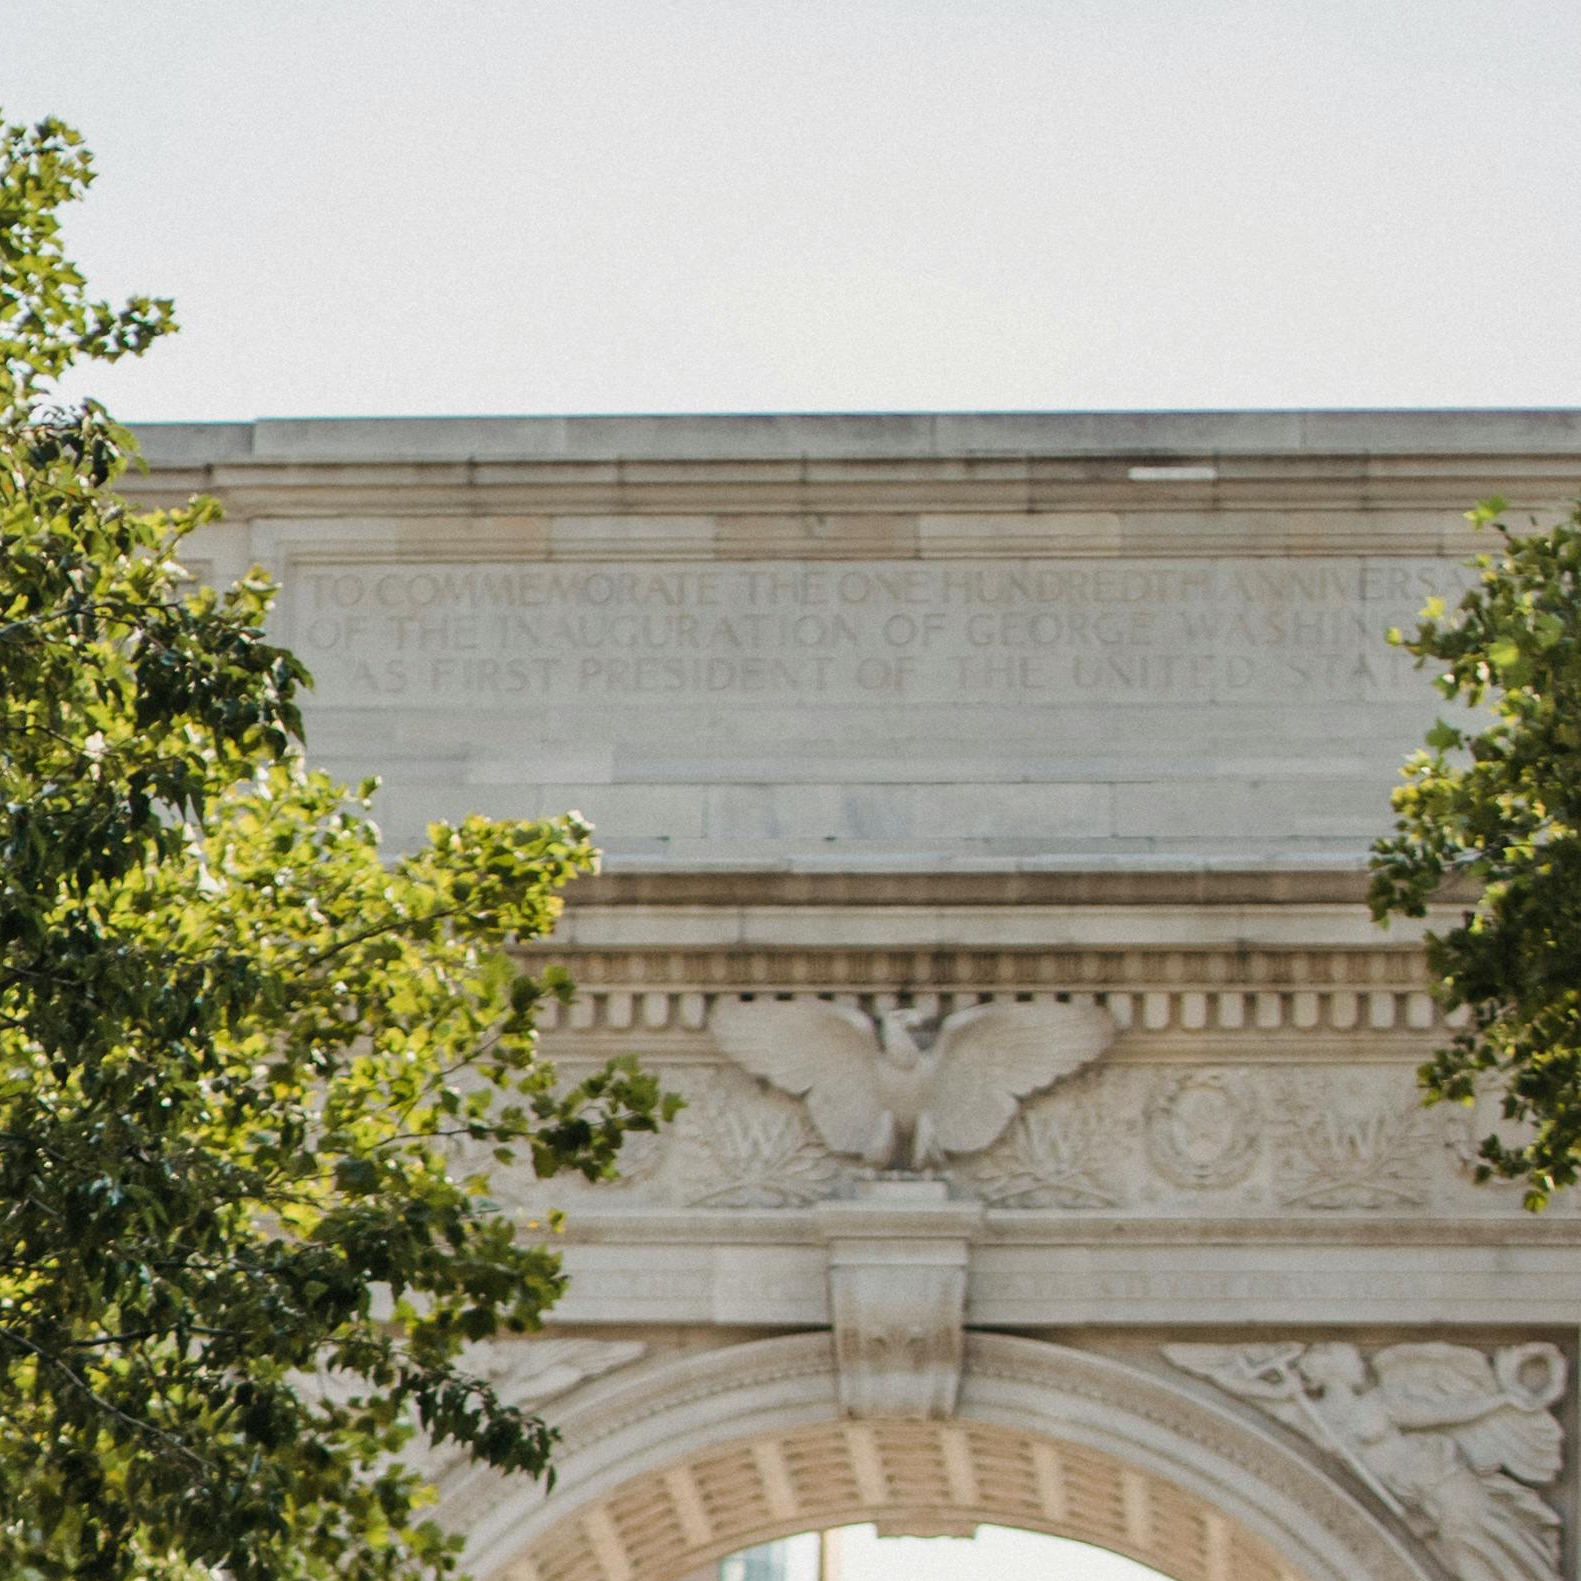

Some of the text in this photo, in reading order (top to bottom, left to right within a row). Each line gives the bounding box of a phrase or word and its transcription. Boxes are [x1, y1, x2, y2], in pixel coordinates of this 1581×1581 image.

[306, 566, 1467, 608] TO COMMEMORATE THE ONE HUNDREDTH ANNIVERSA
[306, 610, 1416, 651] OF THE INAUGURATION OF GEORGE WASHING
[350, 651, 1412, 694] AS FIRST PRESIDENT OF THE UNITED STAT
